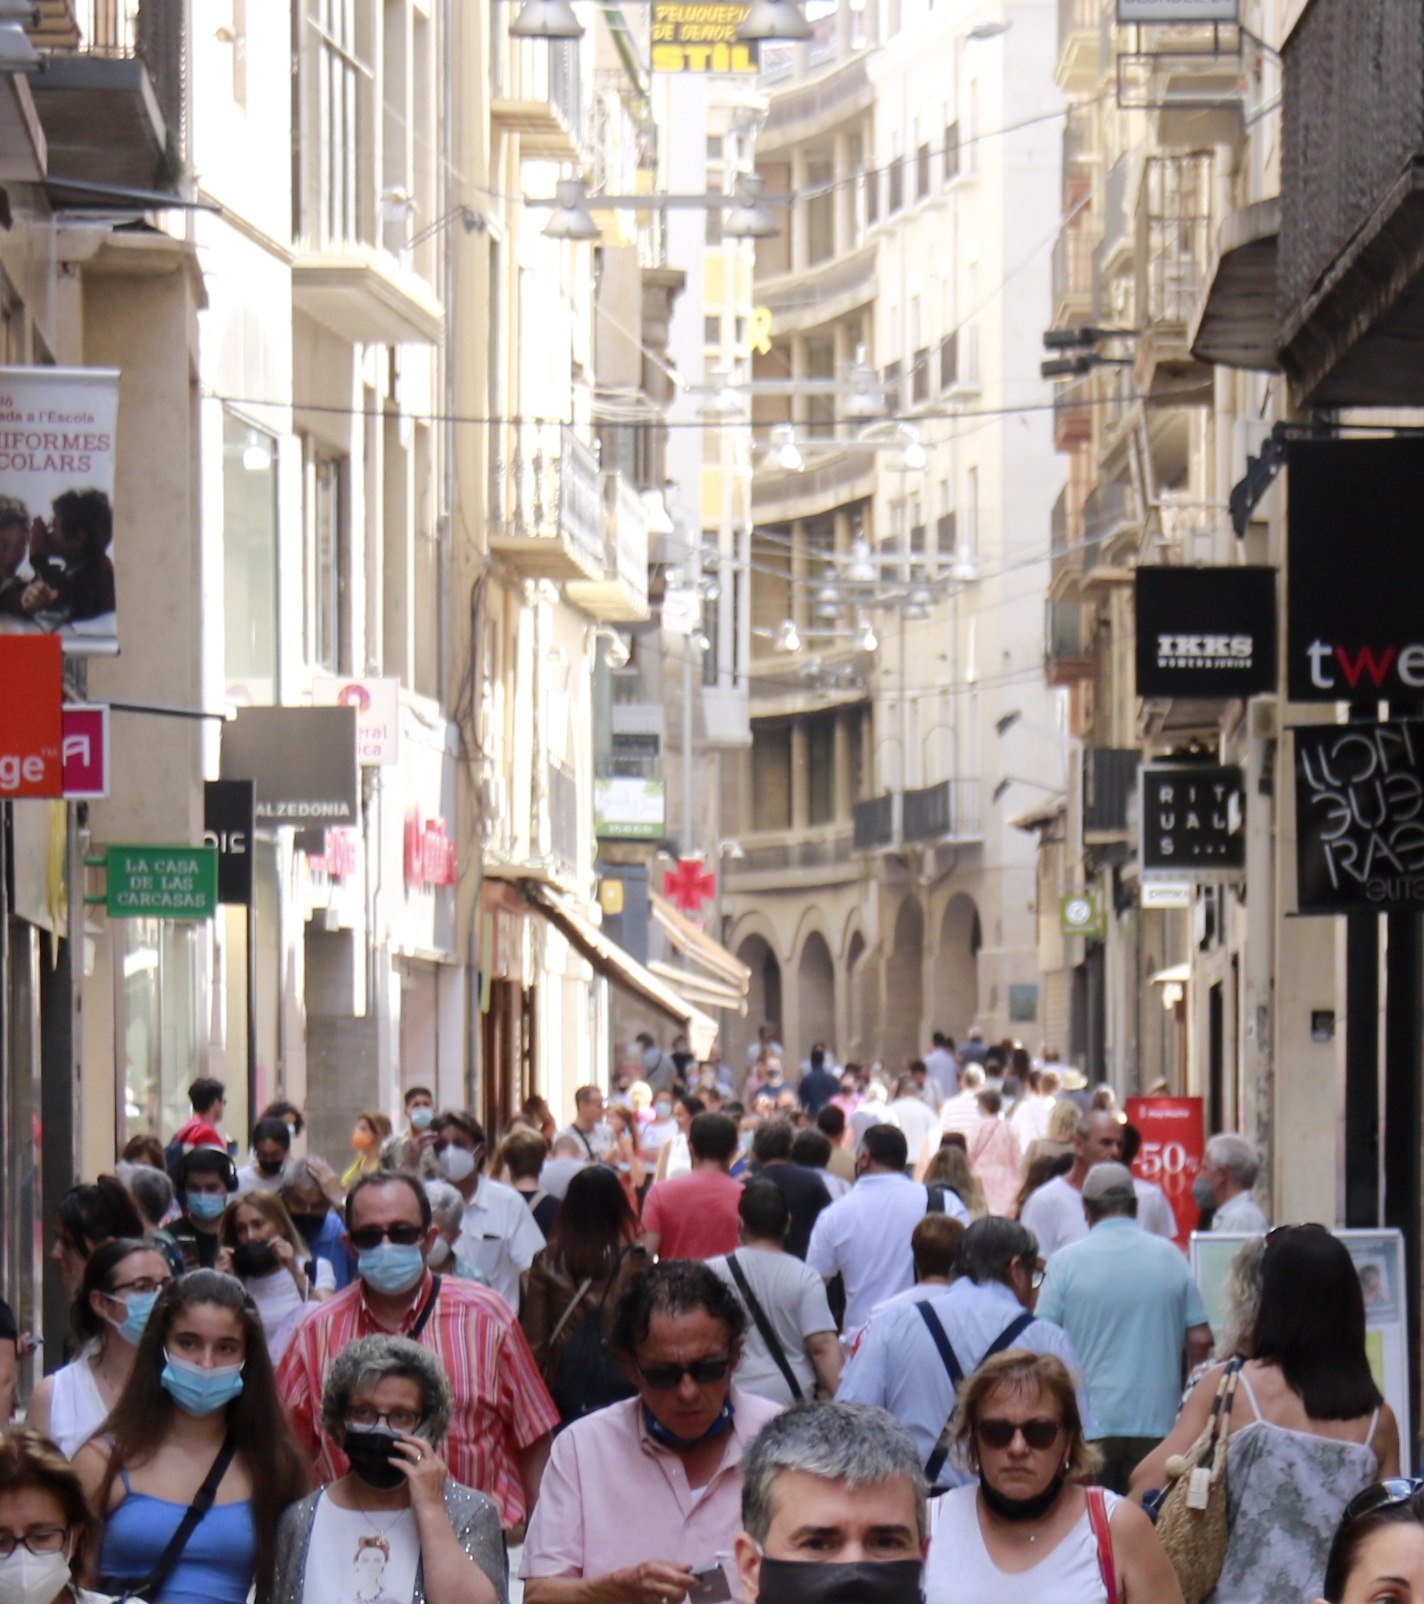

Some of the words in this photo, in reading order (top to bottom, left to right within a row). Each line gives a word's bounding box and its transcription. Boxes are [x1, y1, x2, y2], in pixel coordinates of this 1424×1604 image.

[26, 413, 36, 424] a
[1157, 634, 1253, 658] IKKS
[357, 724, 388, 739] eral
[357, 741, 382, 756] ica
[255, 800, 351, 818] ALZEDONIA
[124, 858, 149, 873] LA
[153, 858, 200, 874] CASA
[129, 876, 153, 891] DE
[160, 876, 194, 892] LAS
[116, 891, 206, 908] CARCASAS
